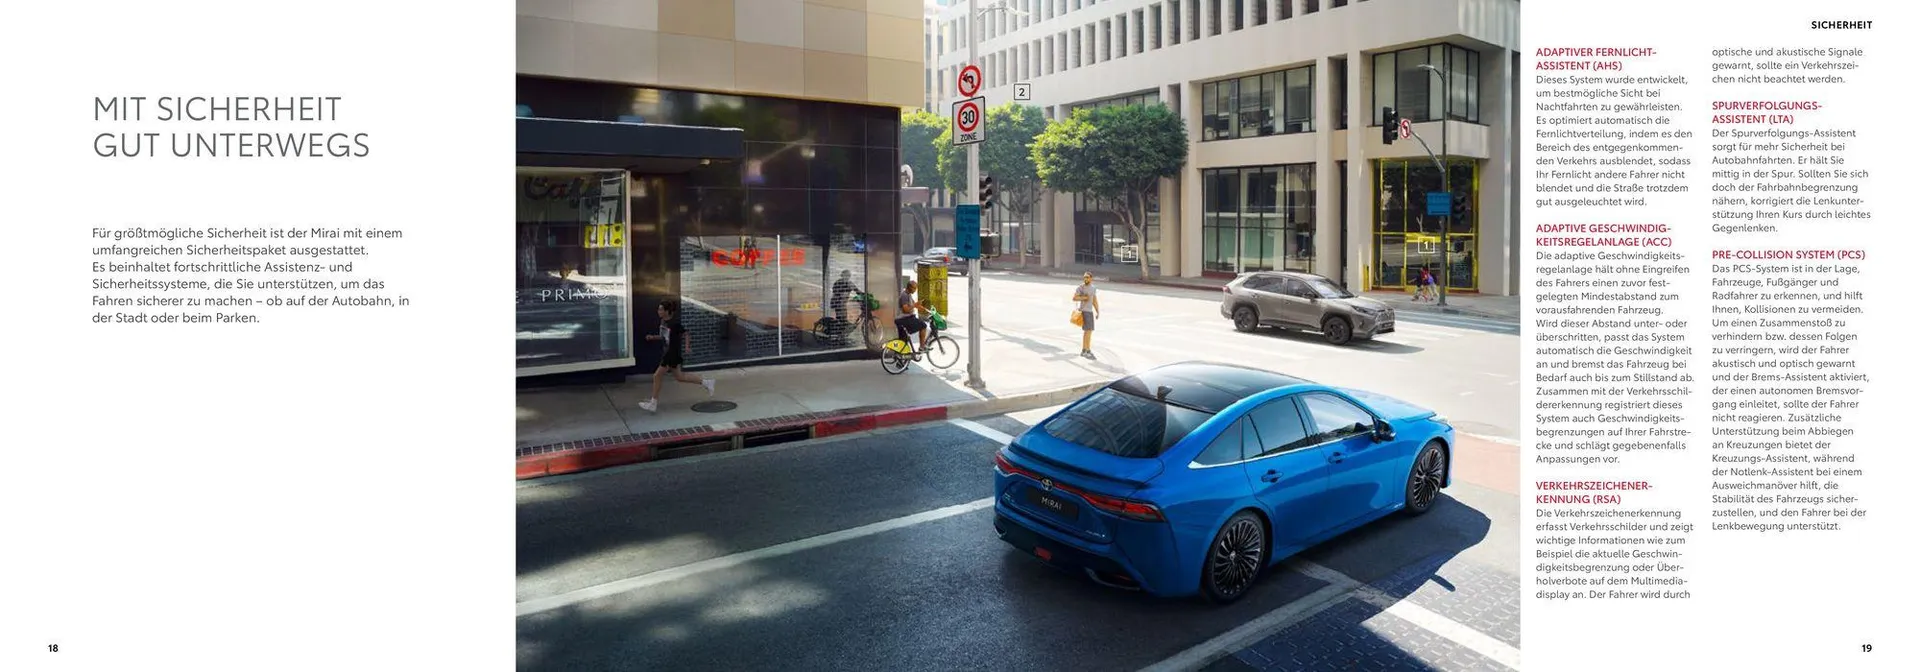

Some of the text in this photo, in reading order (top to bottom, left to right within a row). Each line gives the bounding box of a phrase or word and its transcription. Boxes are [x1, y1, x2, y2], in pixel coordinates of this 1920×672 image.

[1810, 20, 1873, 30] SICHERHEIT
[1535, 47, 1657, 57] ADAPTIVER FERNLICHT-
[1711, 47, 1863, 59] optische und akustische Signale
[1535, 60, 1623, 72] ASSISTENT (AHS)
[1536, 74, 1688, 86] Dieses System wurde entwickelt,
[1535, 88, 1661, 100] um bestmögliche Sicht bei
[94, 96, 342, 122] MIT SICHERHEIT
[1712, 100, 1823, 111] SPURVERFOLGUNGS-
[962, 110, 975, 125] 30
[1711, 114, 1795, 126] ASSISTENT (LTA)
[960, 132, 977, 142] ZONE
[1536, 129, 1693, 141] Fernlichtverteilung, indem es den
[1712, 128, 1857, 140] Der Spurverfolgungs-Assistent
[93, 132, 370, 158] GUT UNTERWEGS
[1711, 155, 1845, 165] Autobahnfahrten. Er hält Sie
[1712, 196, 1864, 208] nähern, korrigiert die Lenkunter-
[92, 226, 403, 242] Für größtmögliche Sicherheit ist der Mirai mit einem
[1535, 223, 1672, 234] ADAPTIVE GESCHWINDIG-
[1535, 236, 1673, 248] KEITSREGELANLAGE (ACC)
[92, 243, 369, 259] umfangreichen Sicherheitspaket ausgestattet.
[1536, 250, 1685, 263] Die adaptive Geschwindigkeits-
[1711, 249, 1866, 261] PRE-COLLISION SYSTEM (PCS)
[92, 260, 353, 273] Es beinhaltet fortschrittliche Assistenz- und
[1536, 264, 1690, 276] regelanlage hält ohne Eingreifen
[92, 277, 385, 292] Sicherheitssysteme, die Sie unterstützen, um das
[92, 295, 134, 307] Fahren
[136, 295, 185, 307] sicherer
[186, 297, 201, 307] zu
[204, 295, 253, 307] machen
[266, 295, 283, 307] ob
[285, 294, 306, 307] auf
[308, 295, 329, 307] der
[331, 294, 395, 308] Autobahn,
[398, 295, 410, 306] in
[1712, 290, 1863, 302] Radfahrer zu erkennen, und hilft
[1535, 304, 1664, 317] vorausfahrenden Fahrzeug.
[91, 311, 260, 324] der Stadt oder beim Parken.
[1711, 318, 1846, 328] Um einen Zusammenstoß zu
[1535, 359, 1687, 371] an und bremst das Fahrzeug bei
[1711, 386, 1864, 396] der einen autonomen Bremsvor-
[1535, 400, 1683, 412] dererkennung registriert dieses
[1712, 412, 1842, 425] nicht reagieren. Zusätzliche
[1535, 440, 1687, 452] cke und schlägt gegebenenfalls
[1711, 453, 1855, 465] Kreuzungs-Assistent, während
[1535, 480, 1653, 491] VERKEHRSZEICHENER-
[1041, 496, 1062, 510] MIRAI
[1536, 494, 1622, 506] KENNUNG (RSA)
[1712, 494, 1859, 506] Stabilität des Fahrzeugs sicher-
[1535, 521, 1694, 534] erfasst Verkehrsschilder und zeigt
[1712, 521, 1841, 533] Lenkbewegung unterstützt.
[1535, 561, 1684, 574] digkeitsbegrenzung oder Über-
[47, 643, 59, 653] 18
[1861, 643, 1873, 653] 19
